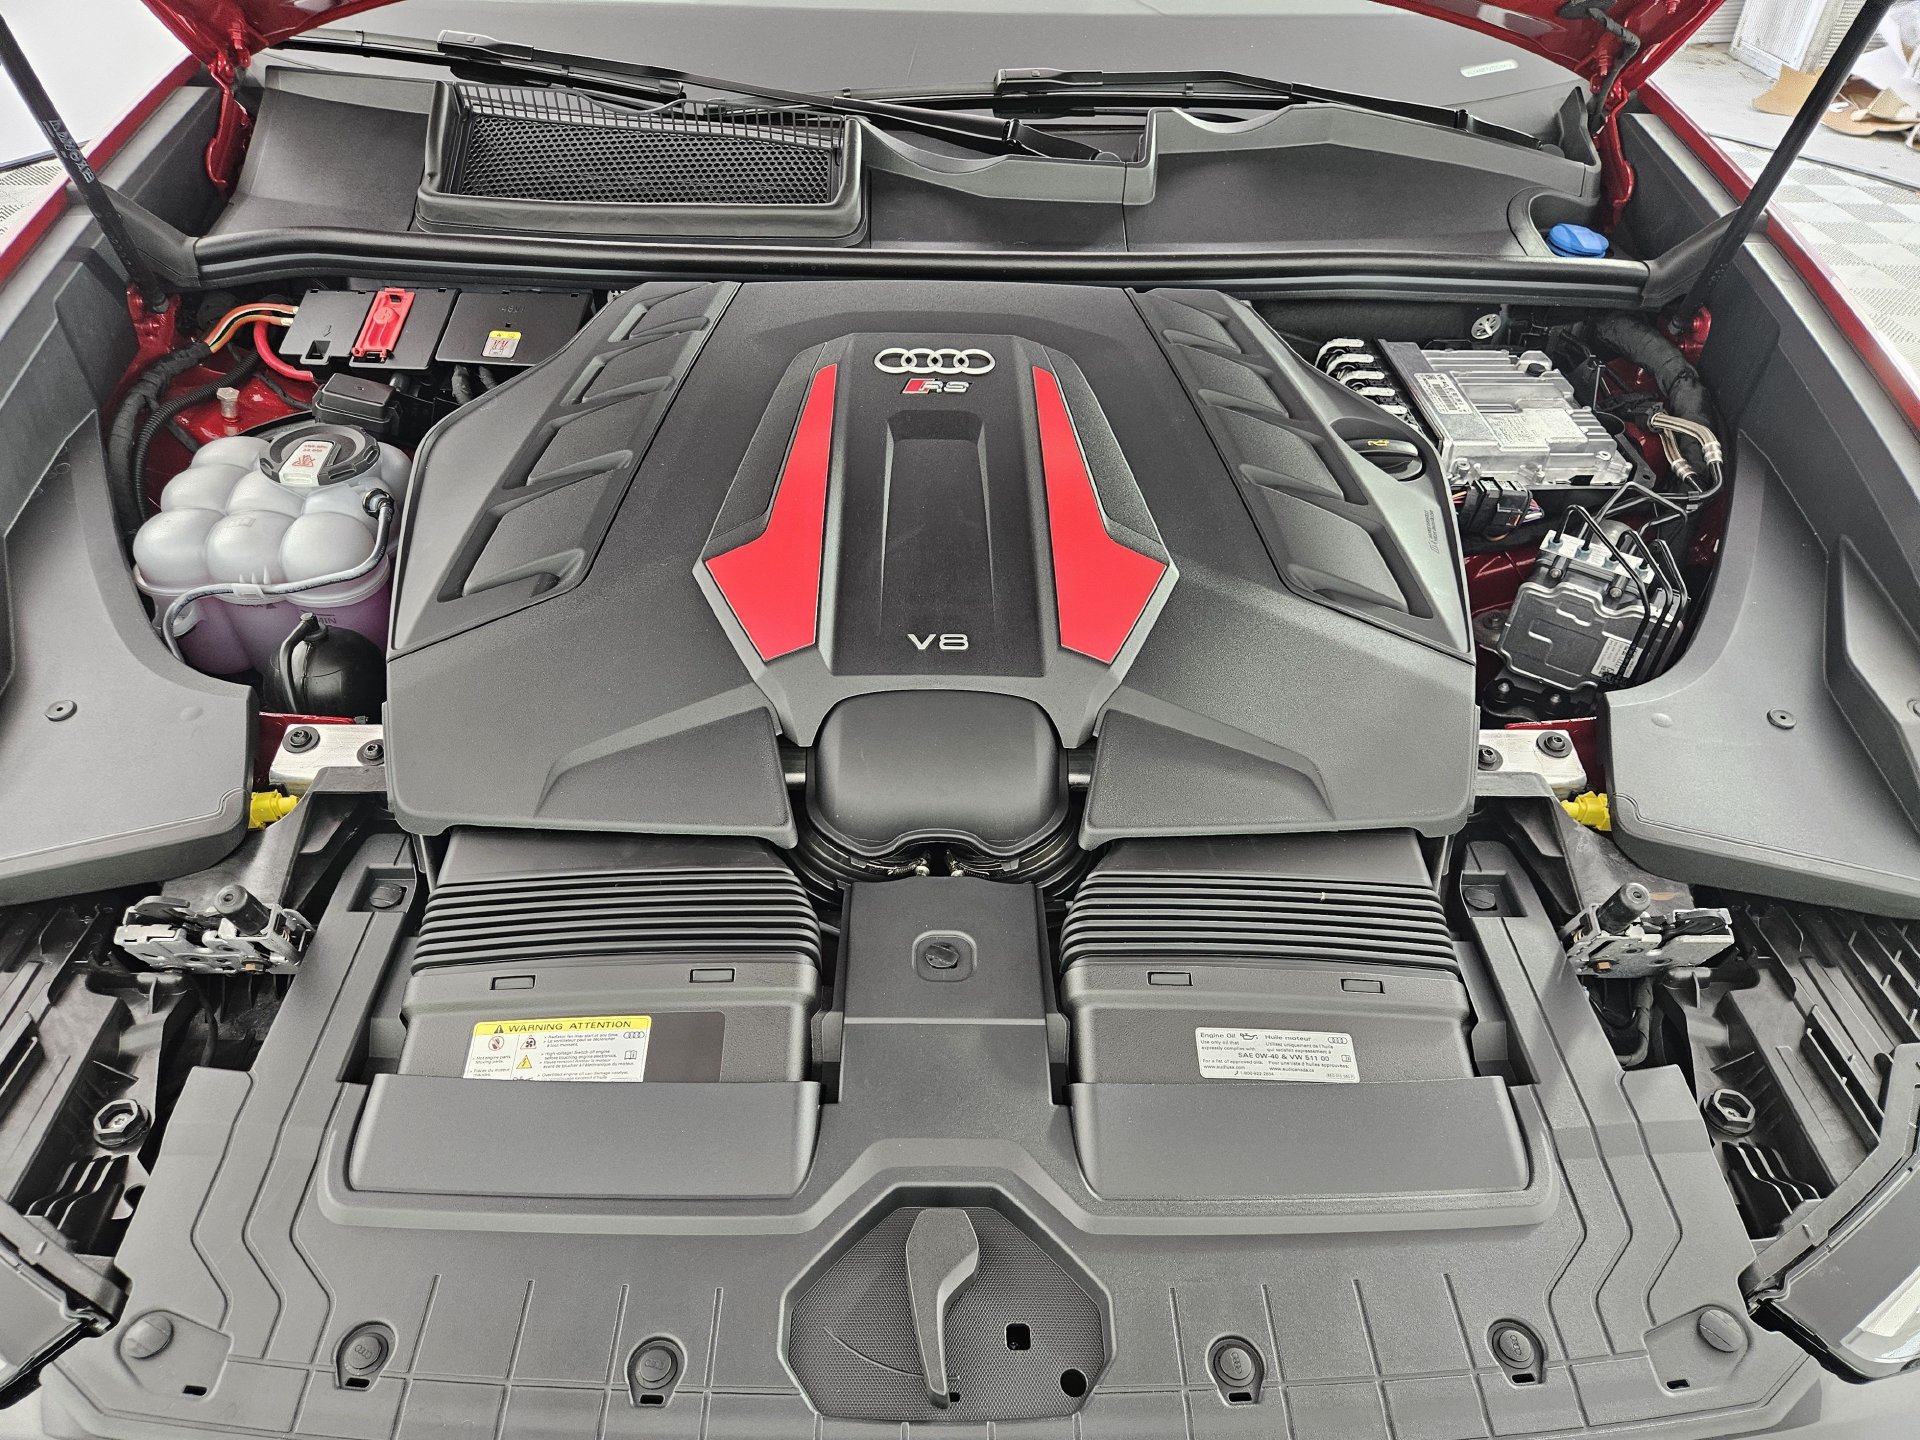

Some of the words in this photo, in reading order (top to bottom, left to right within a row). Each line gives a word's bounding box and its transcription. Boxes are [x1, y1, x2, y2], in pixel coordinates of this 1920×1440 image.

[907, 633, 969, 650] V8
[508, 1022, 563, 1032] WARNING
[569, 1020, 632, 1030] ATTENTION
